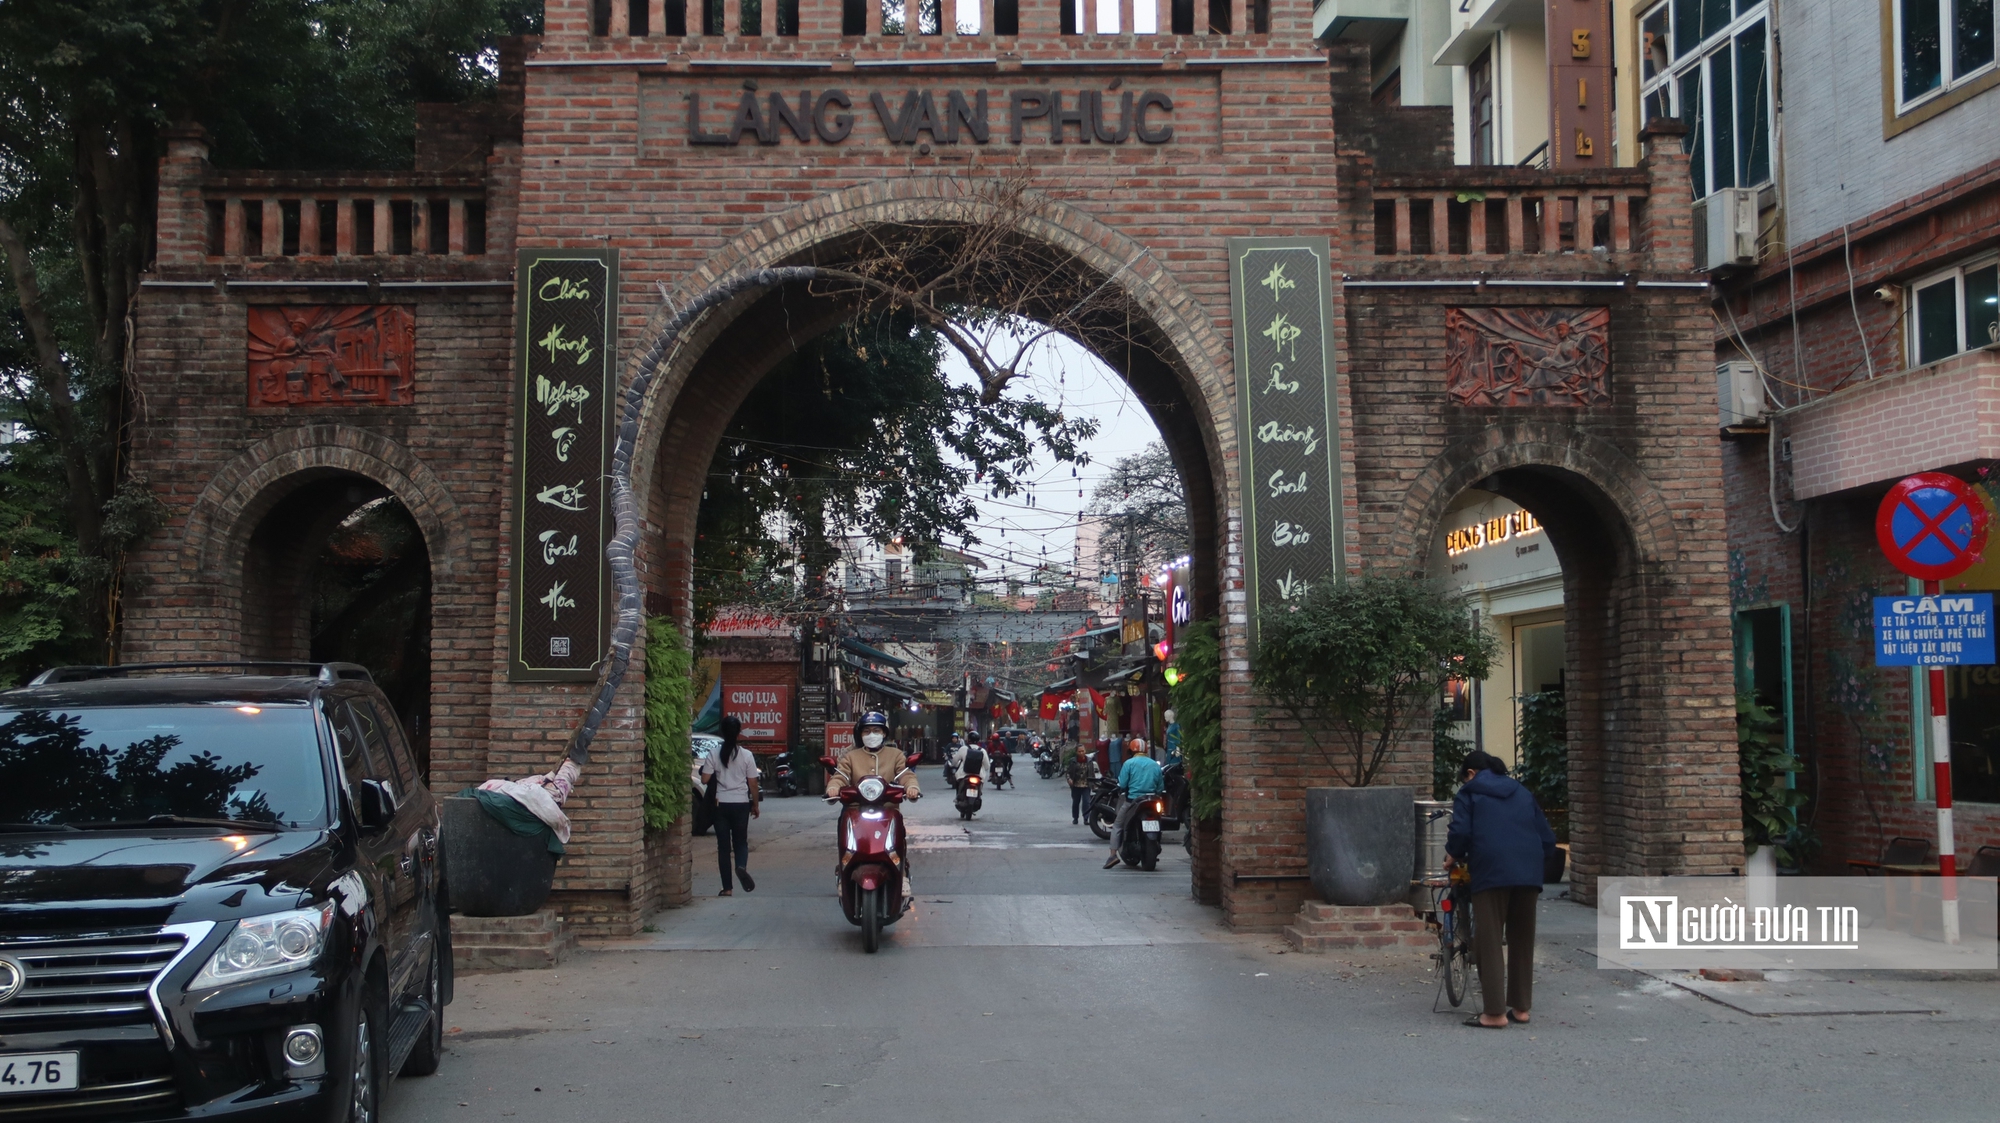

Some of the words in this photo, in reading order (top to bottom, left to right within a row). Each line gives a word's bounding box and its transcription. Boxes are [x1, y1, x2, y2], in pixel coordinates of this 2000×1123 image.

[686, 80, 853, 145] LÀNG
[870, 89, 991, 156] VẠN
[1011, 76, 1175, 145] PHÚC
[1261, 261, 1296, 302] Hoa
[538, 323, 595, 365] Hưng
[1262, 312, 1301, 361] Hợp
[536, 374, 590, 425] Nghiệp
[1268, 469, 1307, 498] Sinh
[538, 530, 578, 565] Tinh
[1271, 520, 1311, 547] Bảo
[540, 579, 576, 621] Hoa
[1892, 594, 1974, 614] CẤM
[1882, 616, 1892, 627] XE
[1895, 613, 1908, 626] TẢI
[1944, 615, 1954, 626] XE
[1970, 610, 1986, 625] CHẾ
[1882, 630, 1892, 641] XE
[1895, 628, 1910, 642] VẬN
[1913, 624, 1944, 640] CHUYỂN
[1947, 625, 1963, 639] PHẾ
[1967, 625, 1986, 638] THẢI
[1883, 642, 1896, 656] VẬT
[1900, 641, 1918, 655] LIỆU
[1940, 641, 1962, 654] DỰNG
[731, 690, 754, 707] CHỢ
[756, 692, 778, 707] LỤA
[753, 709, 783, 724] PHÚC
